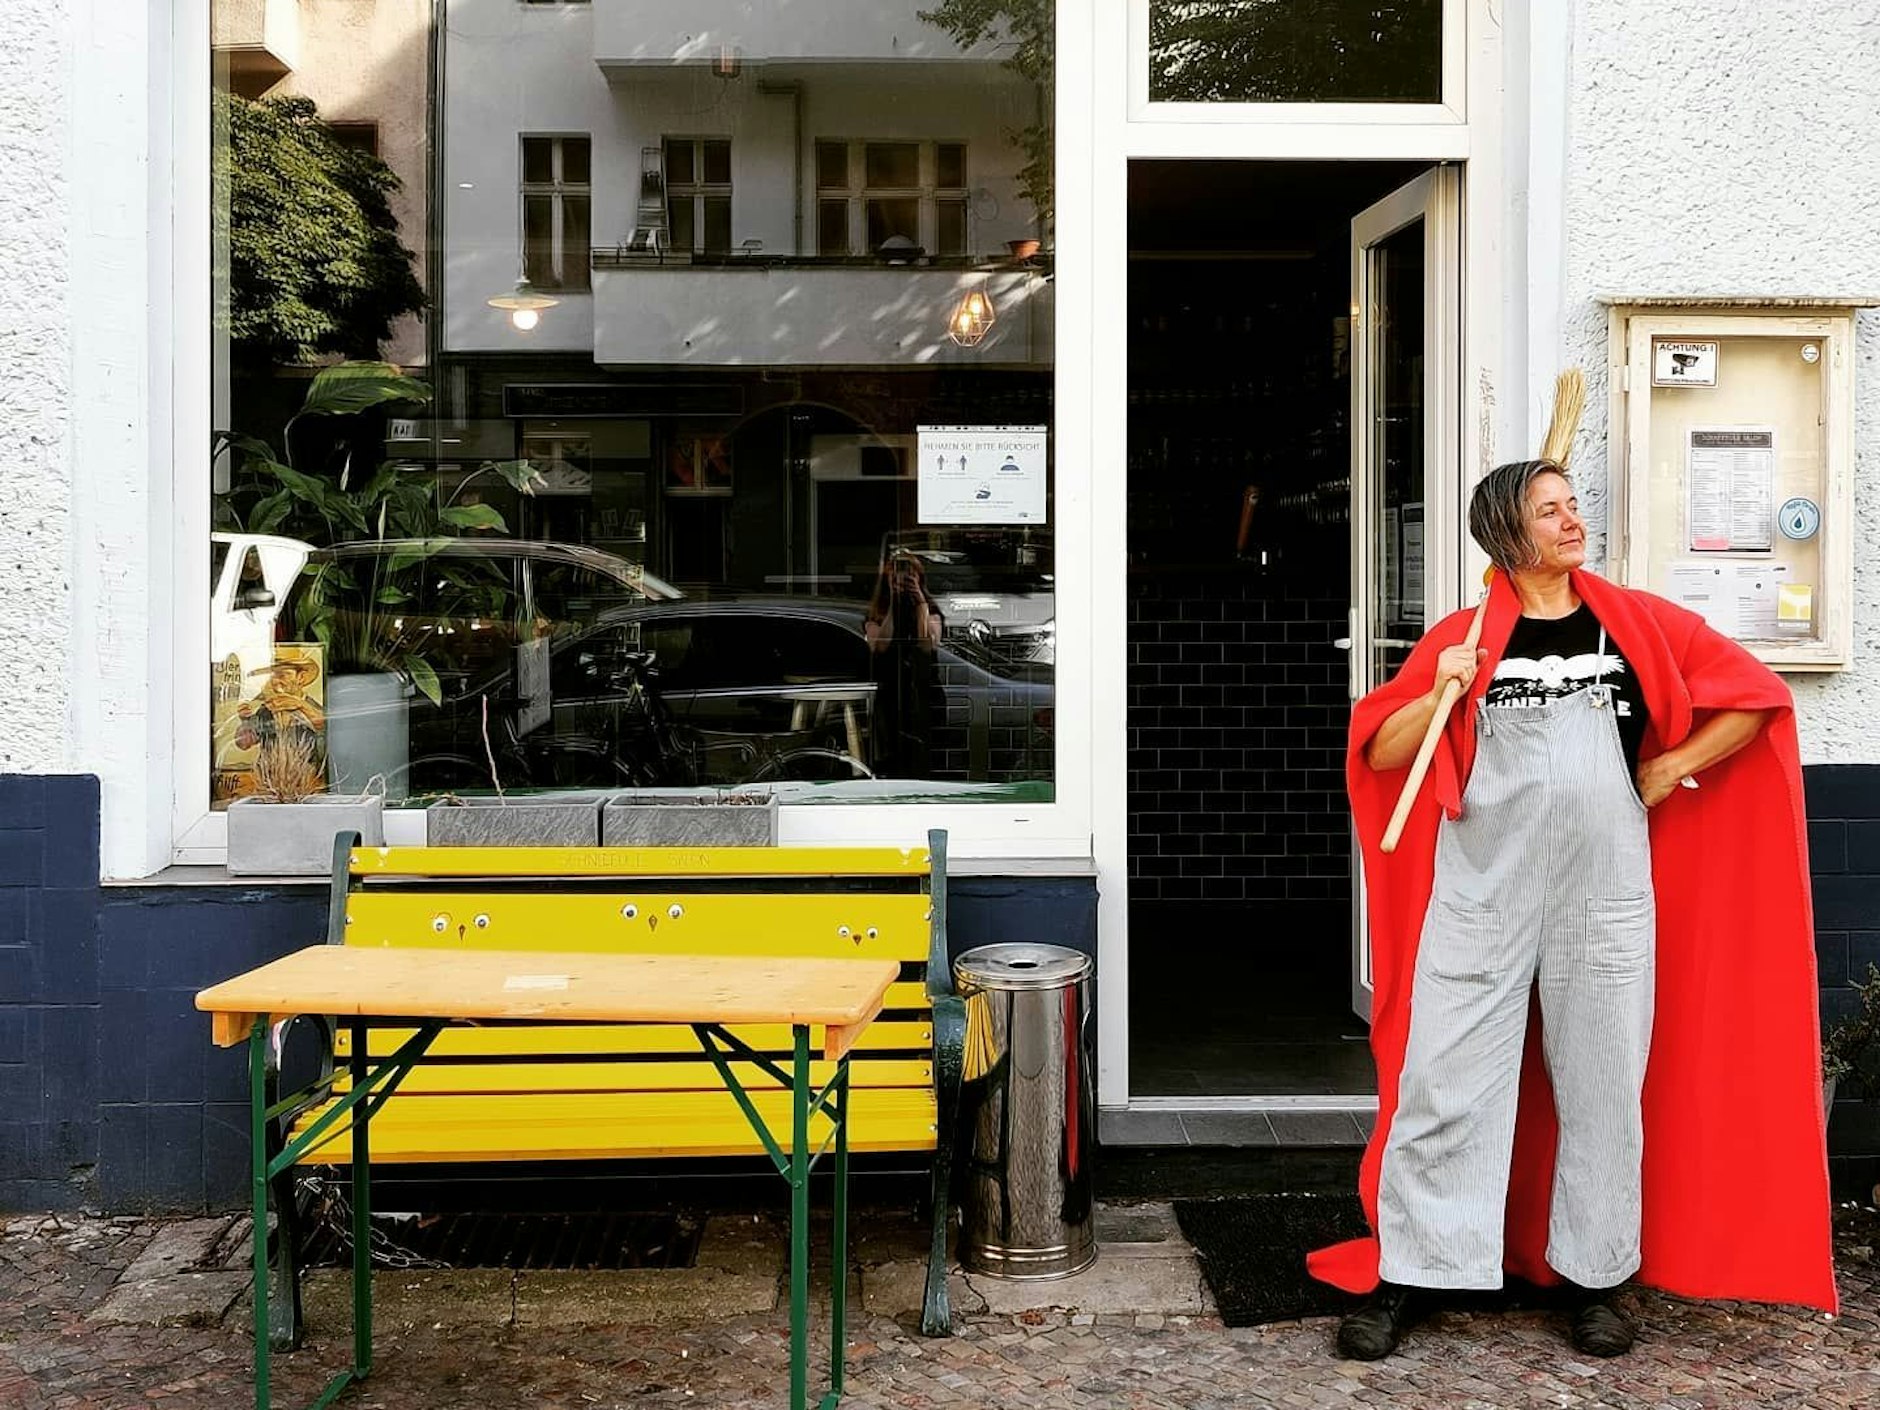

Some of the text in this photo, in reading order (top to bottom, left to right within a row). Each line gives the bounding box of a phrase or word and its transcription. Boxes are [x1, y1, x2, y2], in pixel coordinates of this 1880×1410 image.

[1659, 344, 1707, 352] ACHTUNG
[924, 441, 1040, 451] NEHMEN SIE BITTE RÜCKSICHT
